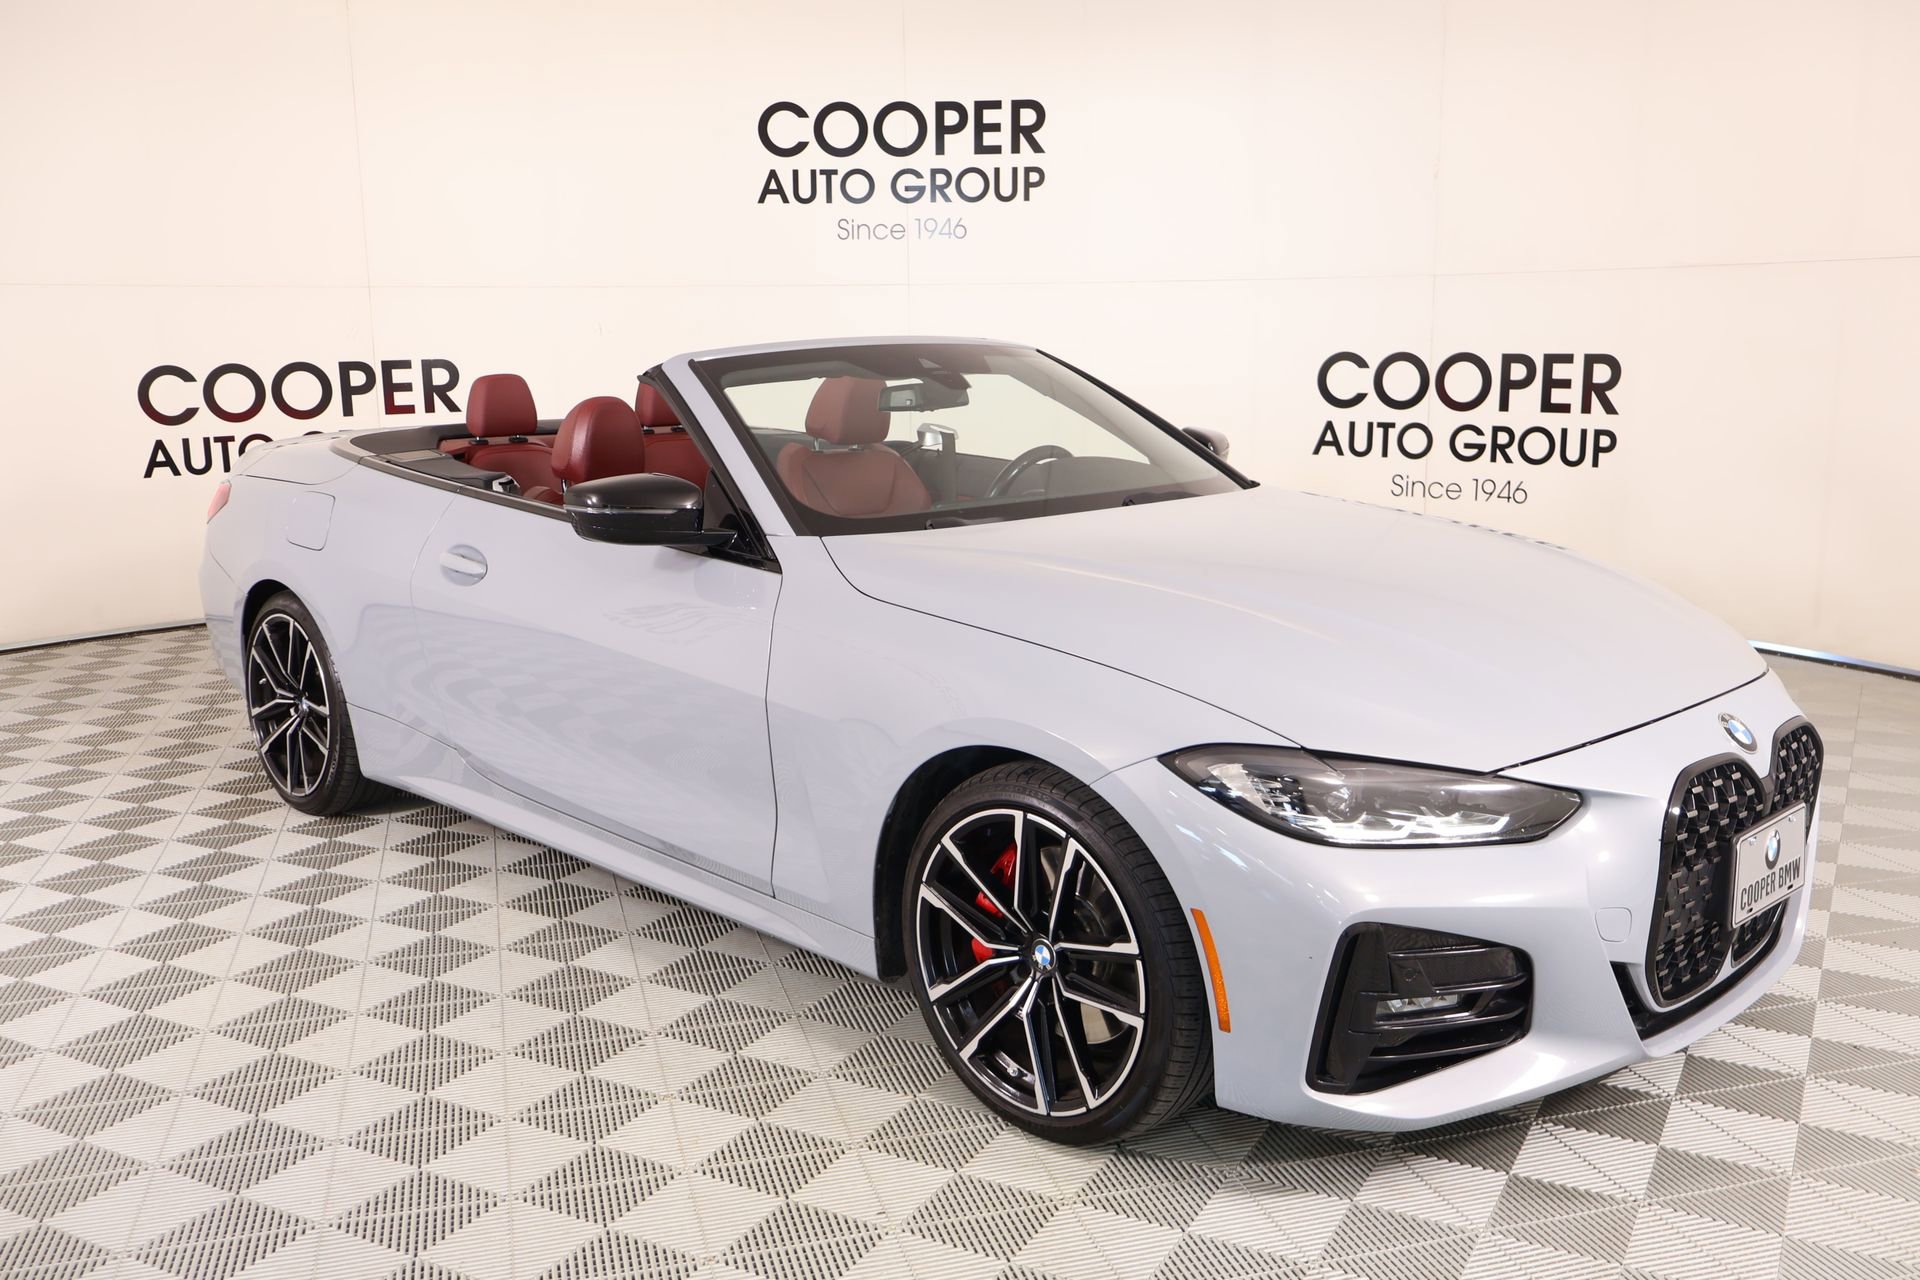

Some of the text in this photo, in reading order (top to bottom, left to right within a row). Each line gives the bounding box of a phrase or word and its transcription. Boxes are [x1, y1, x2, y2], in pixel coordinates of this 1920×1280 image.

[758, 99, 1046, 157] COOPER
[757, 166, 1045, 204] AUTO GROUP
[837, 217, 967, 240] Since 1946
[137, 358, 462, 426] COOPER
[1317, 351, 1622, 415] COOPER
[1312, 420, 1617, 468] AUTO GROUP
[1390, 474, 1528, 504] Since 1946
[1740, 856, 1801, 911] COOPER BMW
